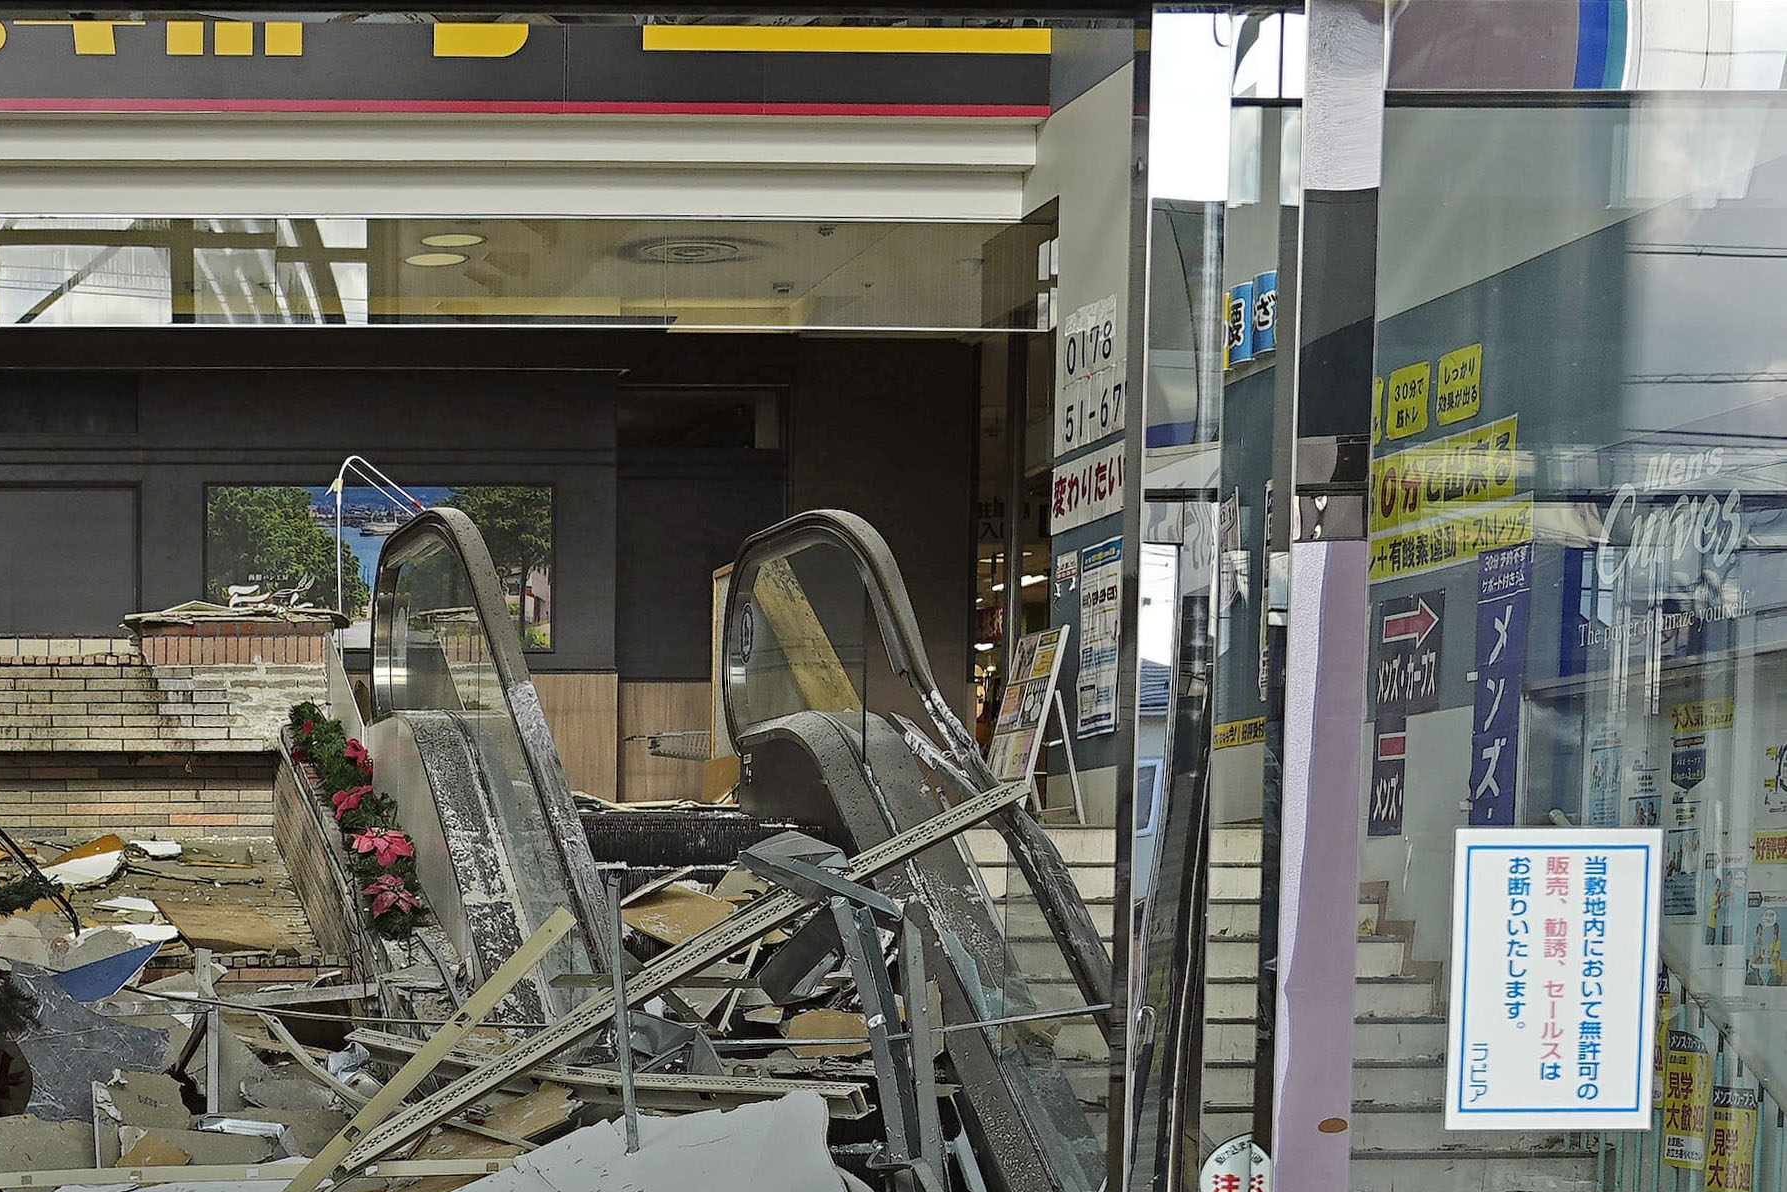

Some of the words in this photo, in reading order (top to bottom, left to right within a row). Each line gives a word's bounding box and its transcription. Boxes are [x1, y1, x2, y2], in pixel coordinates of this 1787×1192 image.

[1065, 319, 1113, 376] 0178
[1065, 382, 1127, 443] 51-67
[1394, 377, 1425, 402] 30分で
[1438, 384, 1478, 413] 効果が出る
[1053, 454, 1126, 519] 変わりたい
[1643, 447, 1725, 492] Men's
[1596, 483, 1741, 584] Curves
[1578, 621, 1601, 648] The
[1604, 619, 1637, 650] power
[1642, 615, 1653, 634] to
[1660, 611, 1695, 631] amaze
[1698, 589, 1750, 632] yourself.
[1503, 856, 1531, 1029] お断りいたします。
[1539, 856, 1570, 1081] 販売、勧誘、セールスは
[1577, 855, 1607, 1101] 当敷地内において無許可の
[1469, 1042, 1488, 1103] ラピア
[1668, 1071, 1695, 1101] 見学
[1666, 1101, 1704, 1133] 大歓迎
[1711, 1128, 1739, 1157] 見学
[1707, 1160, 1750, 1191] 大歓迎
